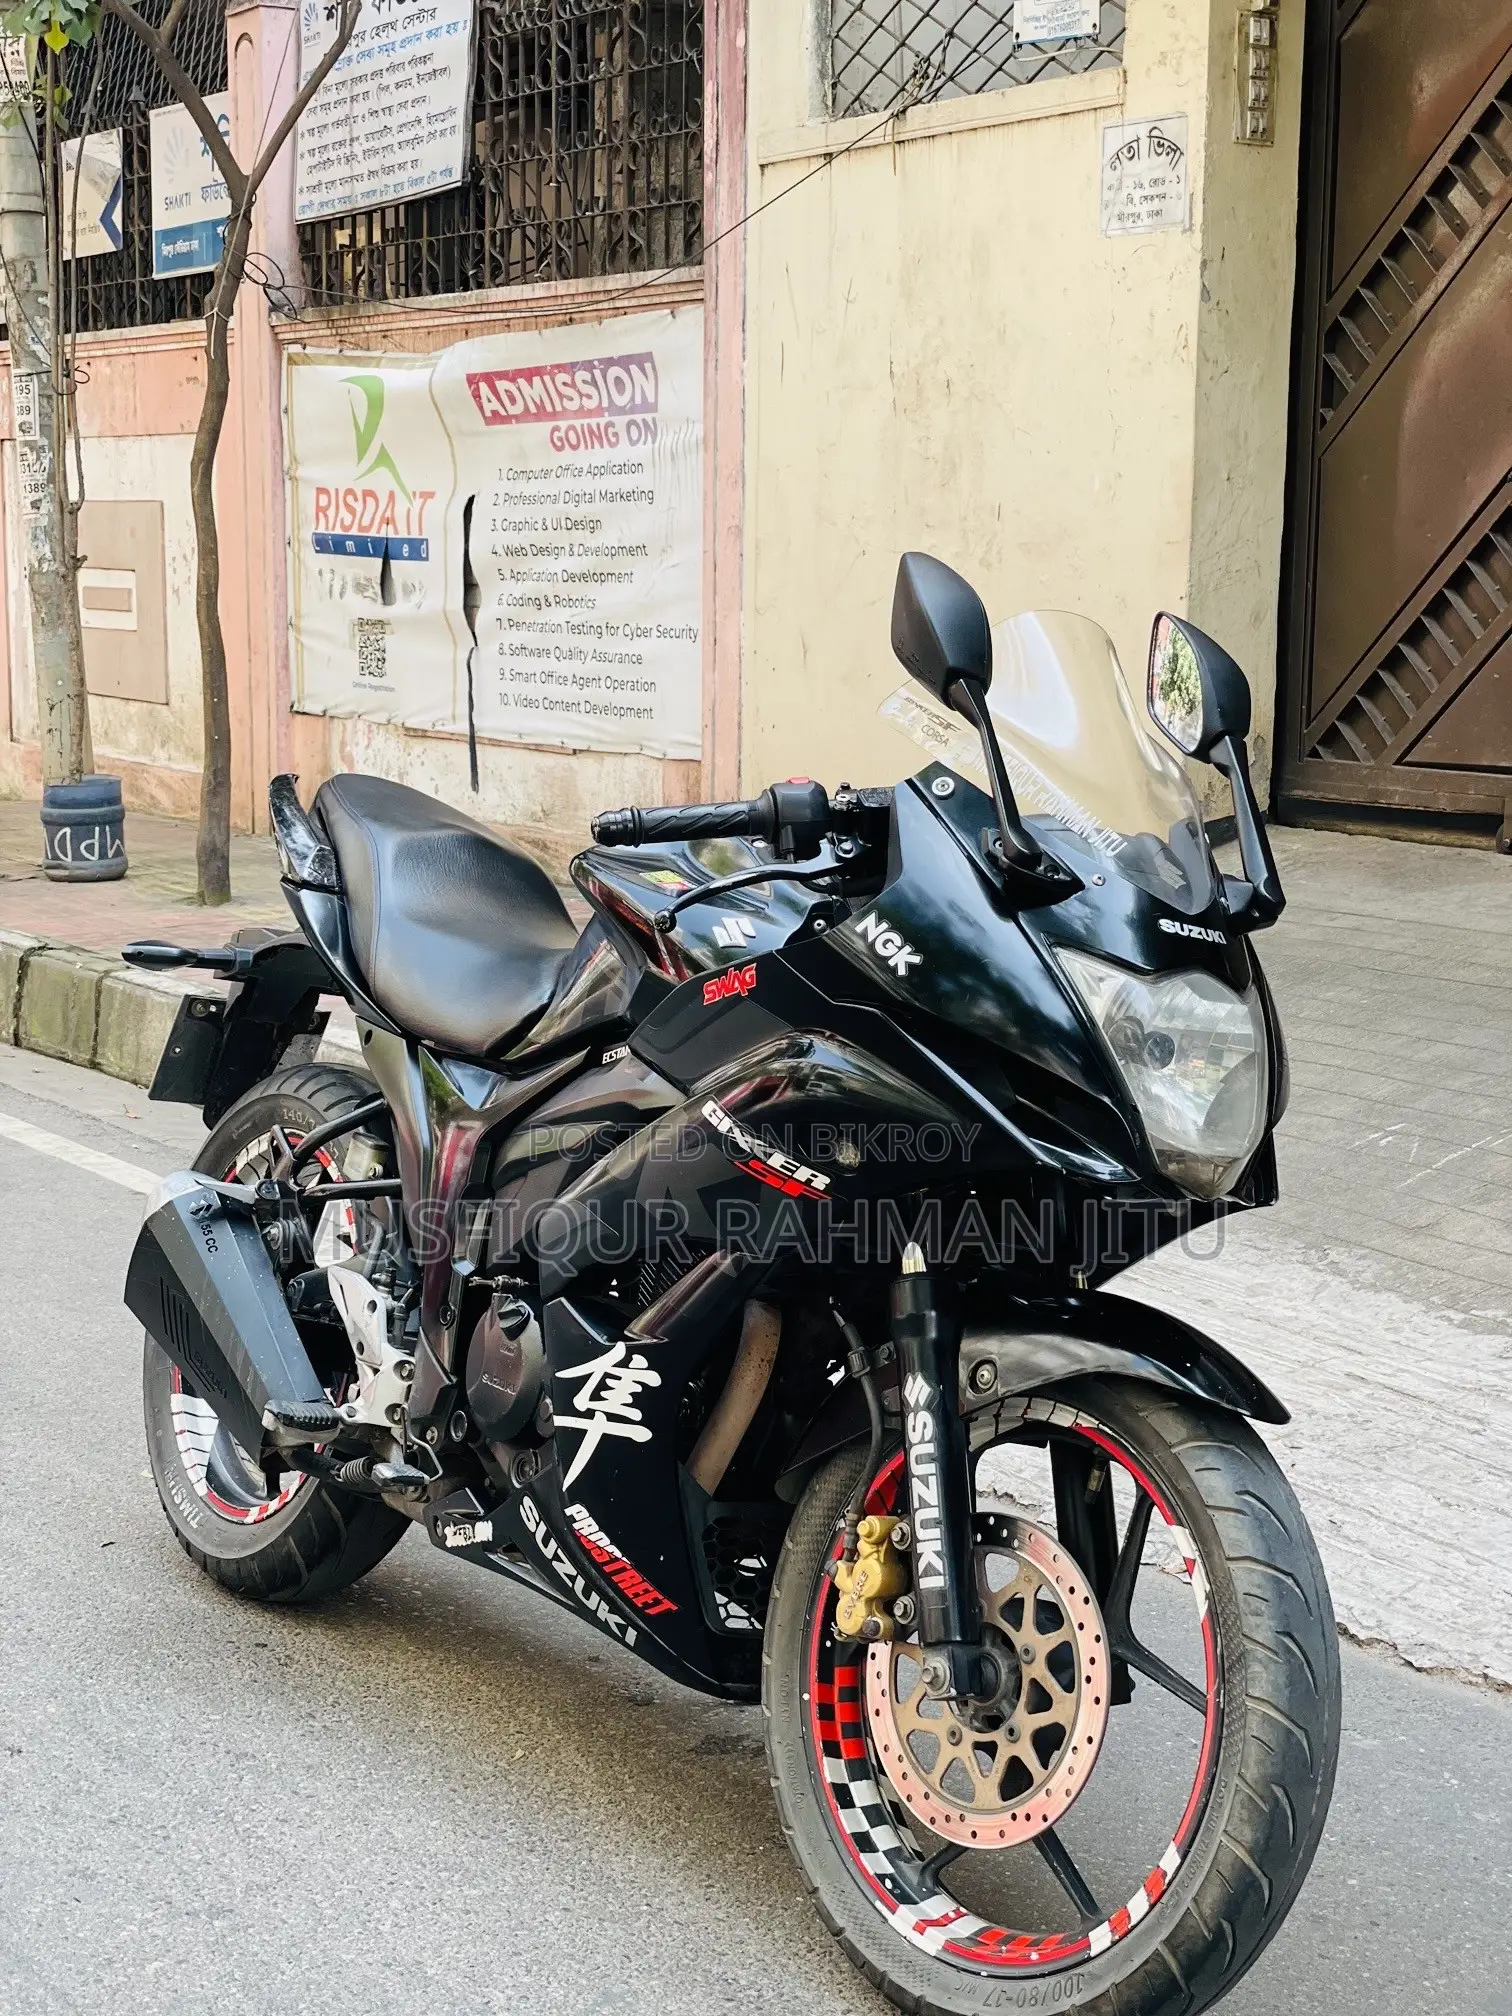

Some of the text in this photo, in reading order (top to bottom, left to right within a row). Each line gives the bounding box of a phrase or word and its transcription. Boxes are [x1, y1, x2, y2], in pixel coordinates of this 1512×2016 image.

[402, 7, 437, 30] সেন্টার
[356, 20, 460, 63] সেবা সমূহ প্রদান করা হয়
[1146, 126, 1185, 171] ভিলা
[1149, 177, 1167, 188] রোড
[165, 192, 192, 211] SHAKTI
[1140, 192, 1167, 205] সেকশন
[1146, 209, 1163, 220] ঢাকা
[478, 360, 656, 418] ADMISSION
[550, 416, 658, 452] GOING ON
[506, 467, 554, 484] Computer
[555, 463, 583, 479] Office
[585, 459, 644, 480] Application
[493, 487, 654, 508] 2. Professional Digital Marketing
[314, 487, 399, 536] RISDA
[491, 518, 499, 532] 3.
[501, 517, 539, 535] Graphic
[541, 518, 548, 530] &
[565, 517, 602, 535] Design
[312, 534, 428, 559] Limied
[491, 543, 648, 560] 4. Web Design & Development
[497, 568, 634, 586] 5. Application Development
[506, 593, 542, 610] Coding
[544, 595, 552, 607] &
[554, 594, 596, 609] Robotics
[496, 617, 699, 643] 7. Penetration Testing for Cyber Security
[498, 642, 643, 665] 8. Software Quality Assurance
[499, 667, 656, 693] 9. Smart Office Agent Operation
[499, 692, 654, 720] 10. Video Content Development
[920, 724, 950, 748] CORSA
[854, 911, 923, 976] NGK
[1157, 918, 1227, 945] SUZUKI
[703, 962, 757, 1006] SWAG
[701, 1100, 832, 1200] GIXXER SF
[206, 1237, 218, 1254] CC
[553, 1341, 662, 1492] 隼
[903, 1408, 950, 1590] SUZUKI
[519, 1495, 641, 1647] SUZUKI
[981, 1973, 1085, 2008] 100/80-17
